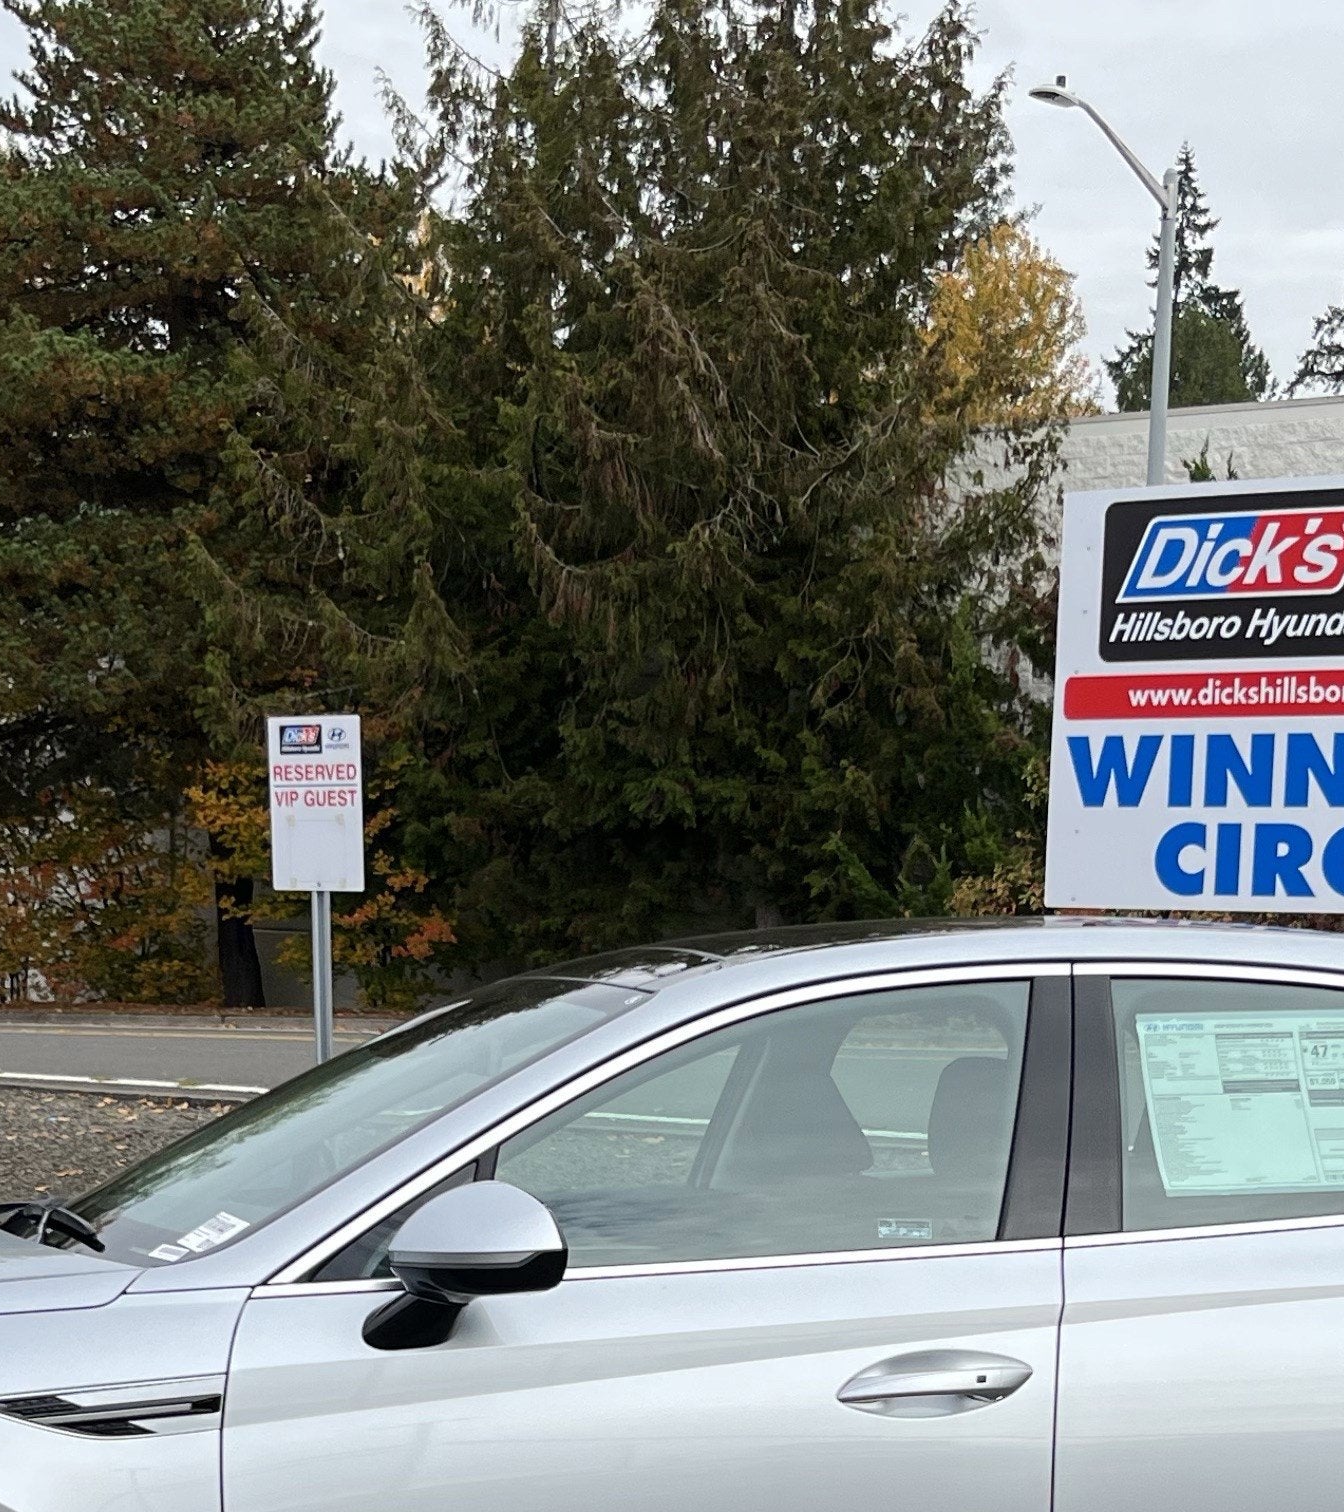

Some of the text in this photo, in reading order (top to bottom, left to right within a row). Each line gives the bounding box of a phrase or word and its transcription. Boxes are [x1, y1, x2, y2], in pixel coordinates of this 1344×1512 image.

[1108, 607, 1239, 645] Hillsboro
[273, 763, 357, 782] RESERVED
[275, 790, 357, 808] VIP GUEST
[1311, 1044, 1328, 1058] 47
